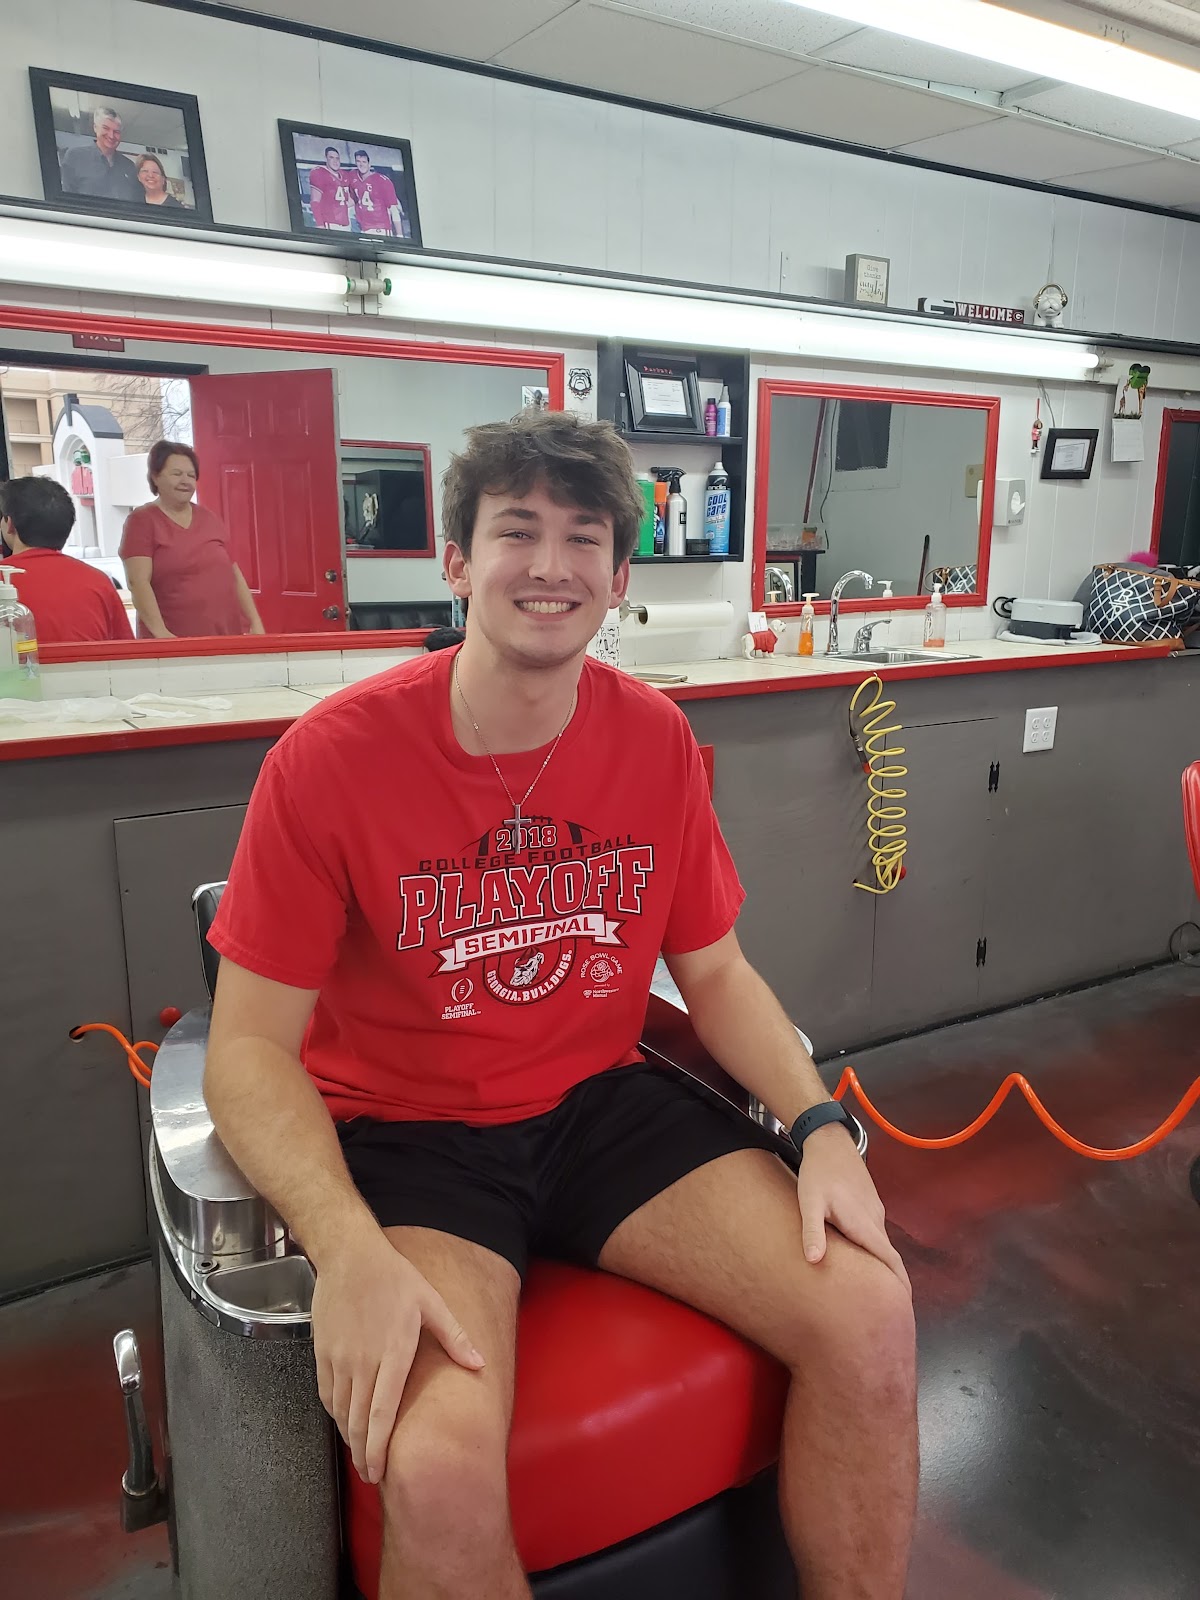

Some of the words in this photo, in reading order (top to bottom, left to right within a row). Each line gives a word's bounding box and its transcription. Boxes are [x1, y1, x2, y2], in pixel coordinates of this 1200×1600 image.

[957, 303, 1013, 321] WELCOME
[495, 825, 557, 852] 2018
[419, 855, 515, 872] COLLEGE
[528, 834, 636, 863] FOOTBALL
[397, 845, 654, 951] PLAYOFF
[464, 916, 596, 956] SEMIFINAL
[487, 969, 519, 1001] GEORGIA
[522, 953, 571, 1001] BULLDOGS
[580, 959, 591, 978] ROSE
[590, 953, 610, 961] BOWL
[610, 956, 623, 975] GAME
[441, 1009, 477, 1020] SEMIFINAL
[444, 1002, 474, 1013] PLAYOFF
